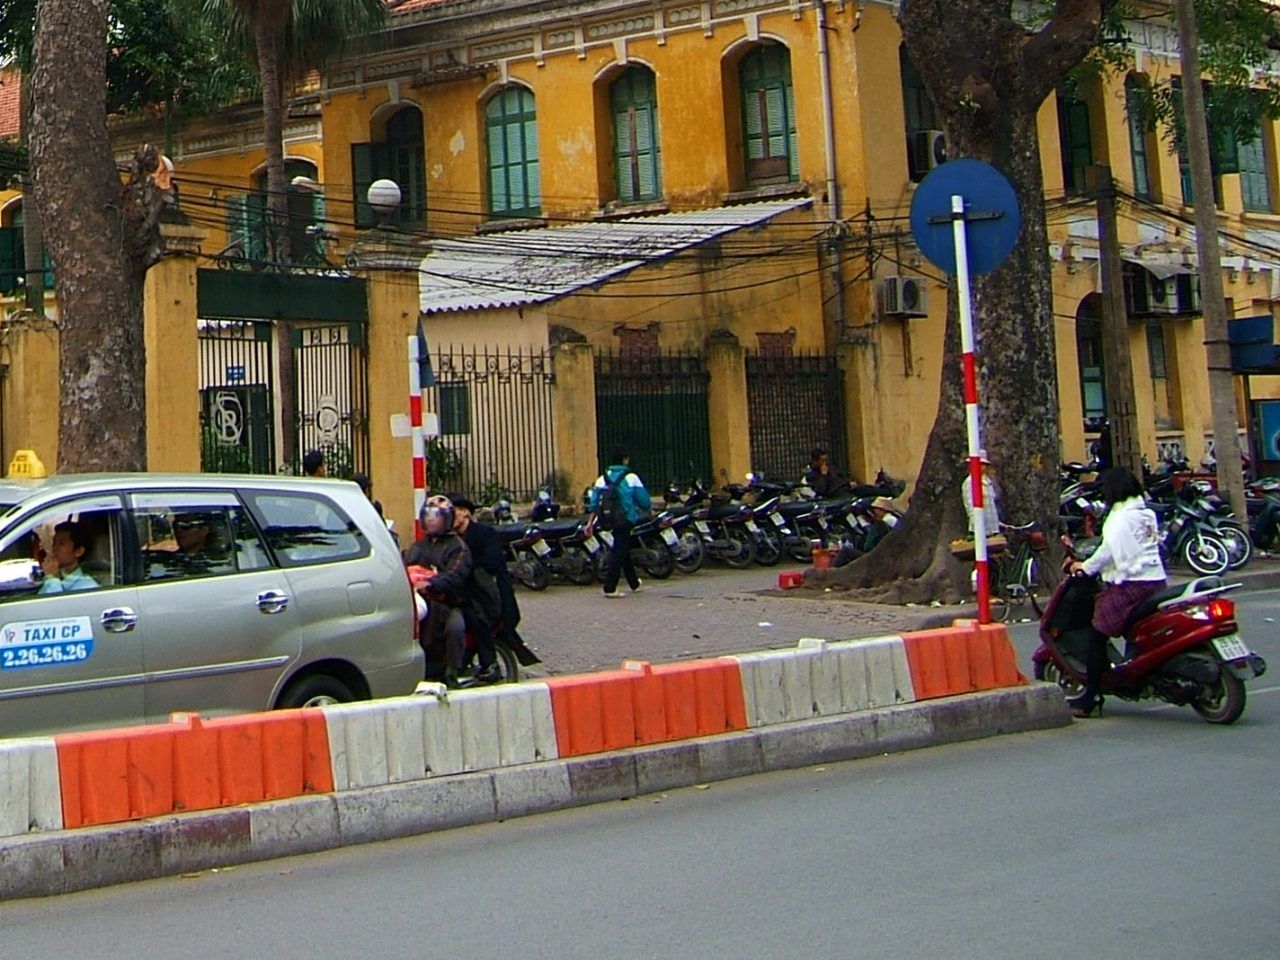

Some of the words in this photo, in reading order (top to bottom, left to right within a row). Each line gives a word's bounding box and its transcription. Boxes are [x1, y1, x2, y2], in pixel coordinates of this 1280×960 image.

[23, 627, 56, 642] TAXI
[61, 625, 81, 638] CP
[3, 643, 87, 667] 2.26.26.26
